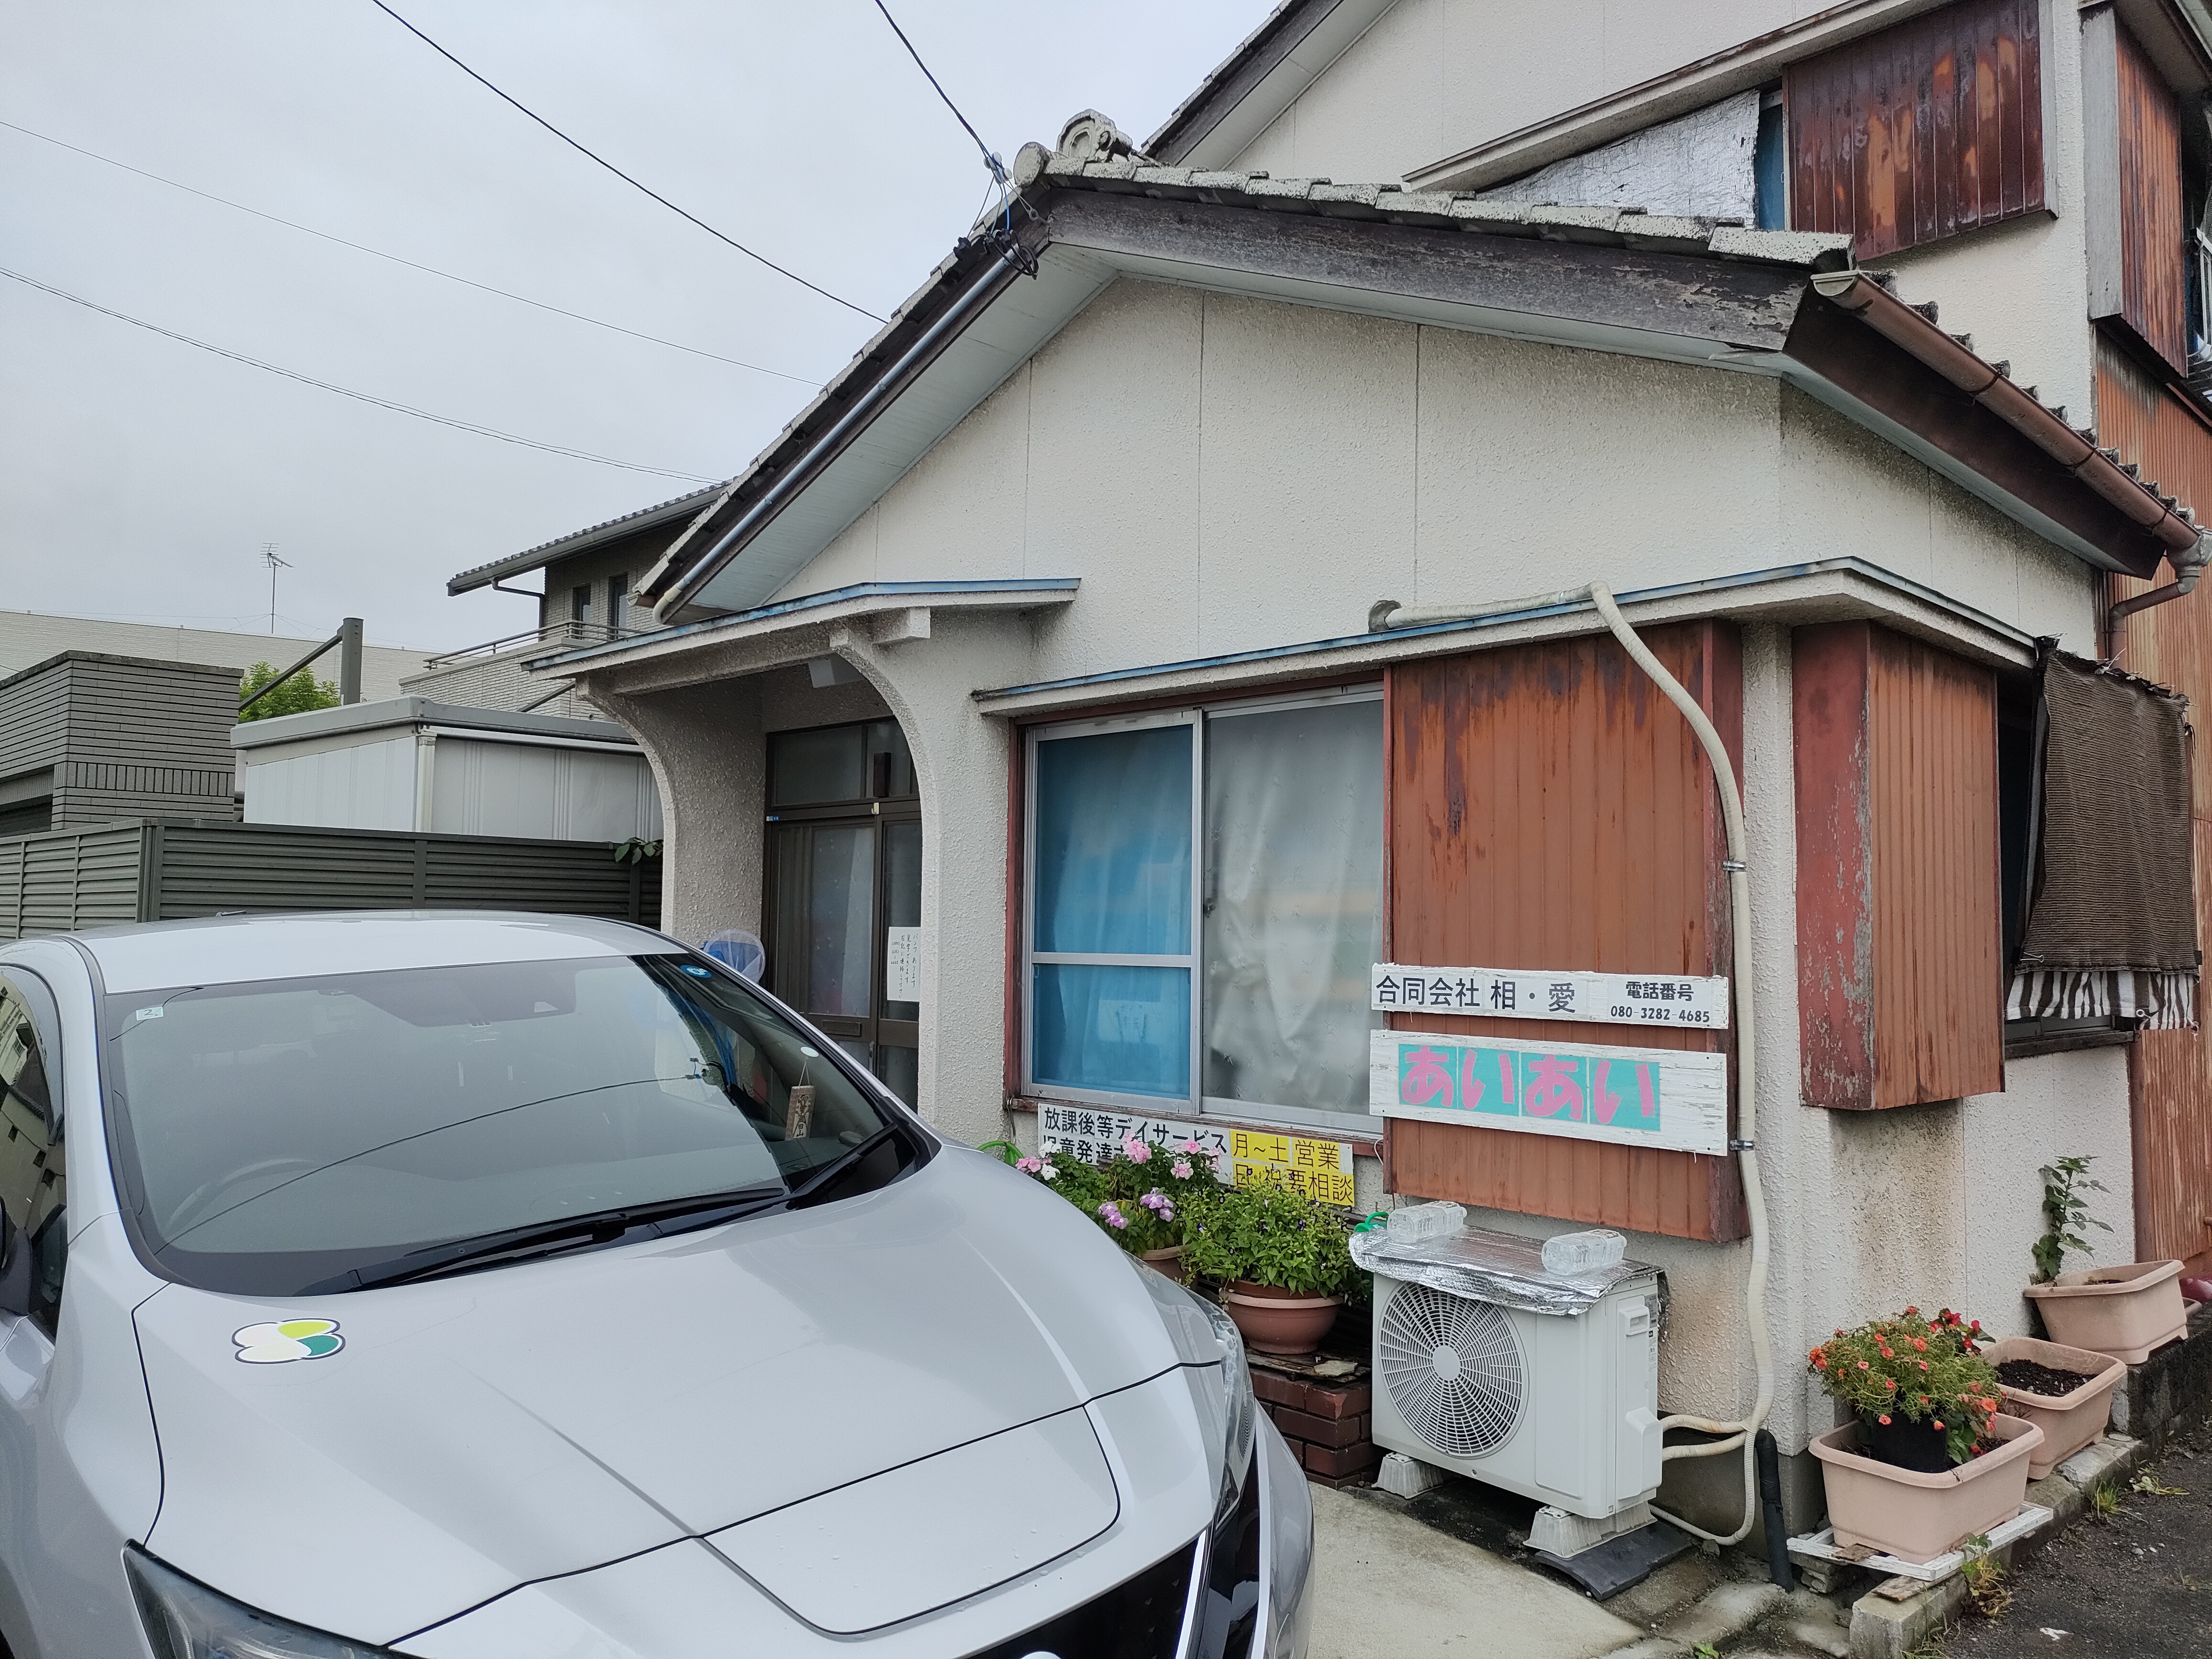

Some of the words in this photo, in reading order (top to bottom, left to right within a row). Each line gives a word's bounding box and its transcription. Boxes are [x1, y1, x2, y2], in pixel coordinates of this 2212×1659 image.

[1626, 981, 1694, 1001] 電話番号
[1611, 1006, 1710, 1023] 080-3282-4685
[1402, 1046, 1655, 1124] あいあい
[1045, 1107, 1227, 1153] 放課後等デイサービス
